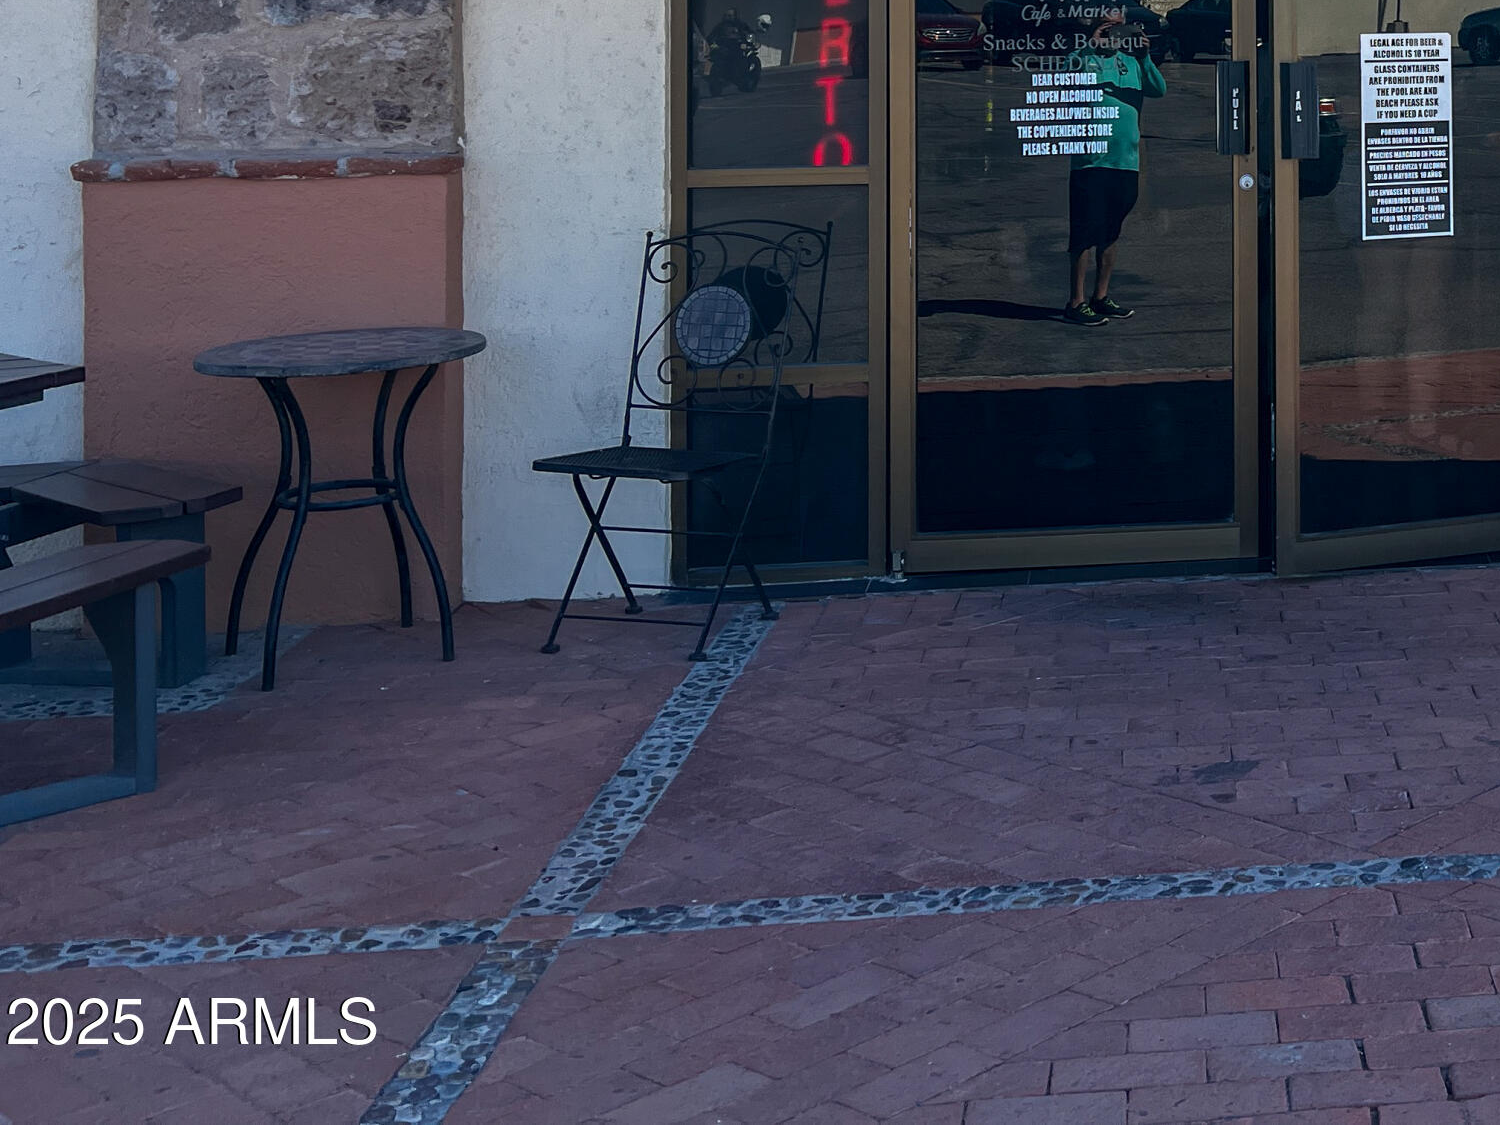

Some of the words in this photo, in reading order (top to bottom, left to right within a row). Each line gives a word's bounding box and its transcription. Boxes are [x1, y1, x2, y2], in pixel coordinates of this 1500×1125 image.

[1057, 9, 1066, 18] &
[1068, 5, 1127, 18] Market
[983, 34, 1045, 51] Snacks
[1051, 34, 1067, 50] &
[1370, 39, 1389, 47] LEGAL
[1391, 38, 1404, 46] AGE
[1406, 38, 1418, 46] FOR
[1420, 38, 1436, 46] BEER
[1373, 50, 1403, 58] ALCOHOL
[1424, 49, 1440, 57] YEAR
[1374, 65, 1396, 73] GLASS
[1398, 64, 1440, 73] CONTAINERS
[1032, 74, 1053, 86] DEAR
[1054, 73, 1096, 86] CUSTOMER
[1369, 77, 1382, 85] ARE
[1384, 76, 1424, 85] PROHIBITED
[1426, 75, 1445, 83] FROM
[1026, 91, 1037, 104] NO
[1039, 91, 1059, 103] OPEN
[1060, 90, 1103, 102] ALCOHOLIC
[1377, 88, 1389, 96] THE
[1391, 88, 1408, 96] POOL
[1424, 87, 1437, 95] AND
[1232, 87, 1240, 130] PULL
[1376, 99, 1398, 107] BEACH
[1400, 98, 1424, 107] PLEASE
[1425, 98, 1439, 106] ASK
[1010, 108, 1055, 121] BEVERAGES
[1056, 107, 1092, 120] ALLOWED
[1093, 107, 1119, 119] INSIDE
[1377, 110, 1384, 119] IF
[1385, 110, 1398, 119] YOU
[1400, 110, 1416, 118] NEED
[1418, 109, 1423, 117] A
[1424, 109, 1438, 117] CUP
[1017, 126, 1032, 138] THE
[1034, 125, 1086, 138] CONVENIENCE
[1088, 124, 1112, 136] STORE
[1023, 143, 1050, 156] PLEASE
[1052, 144, 1058, 155] &
[1059, 142, 1085, 154] THANK
